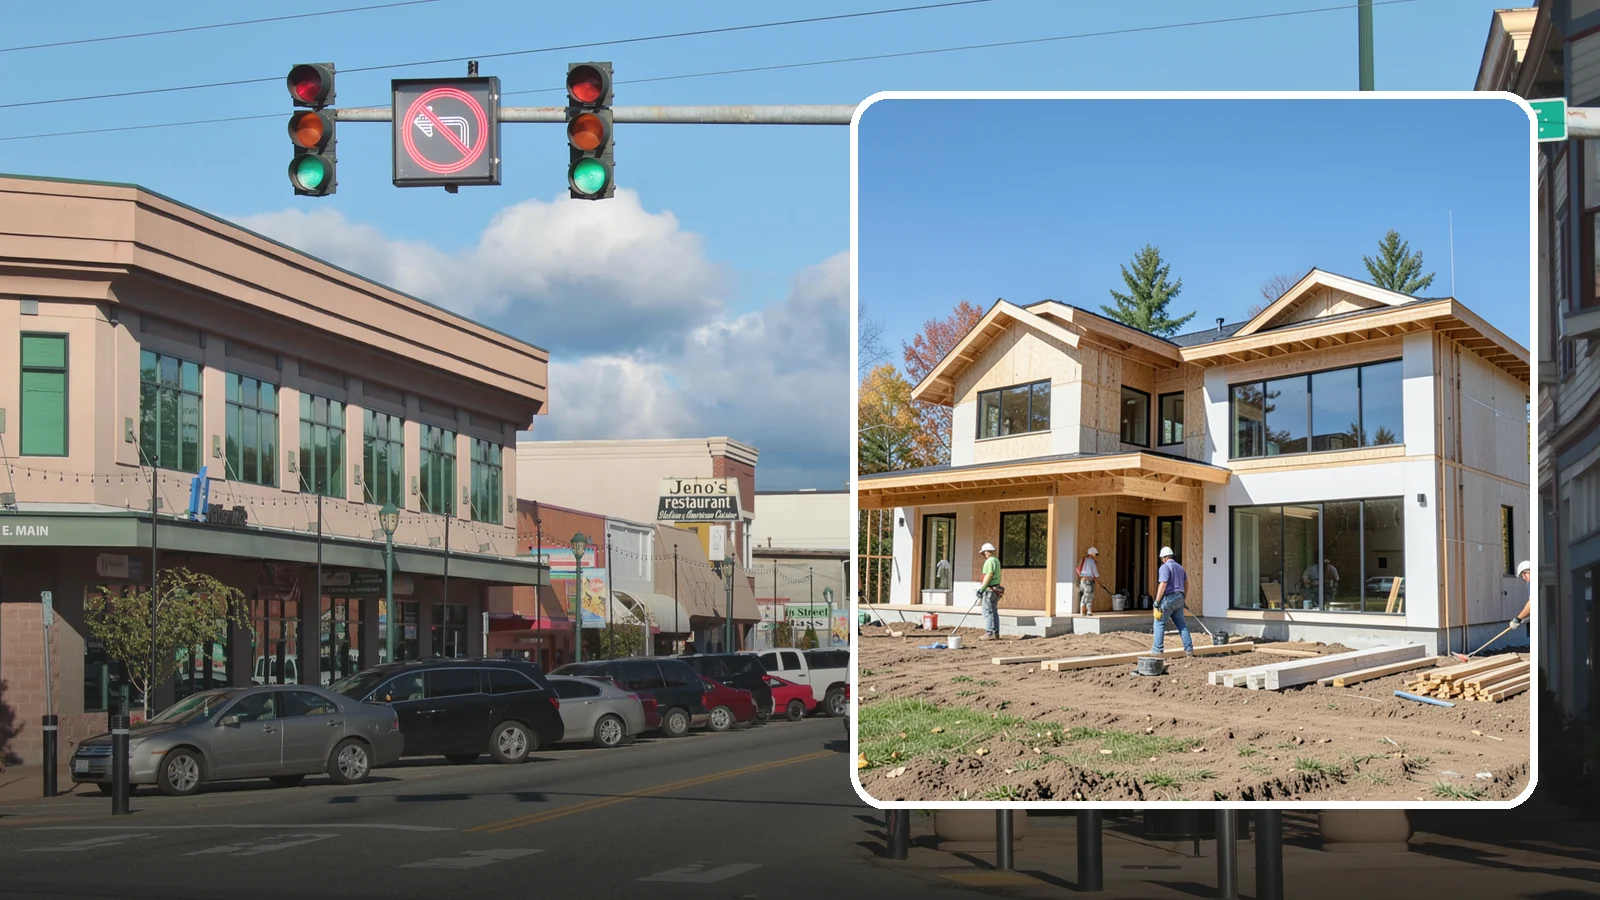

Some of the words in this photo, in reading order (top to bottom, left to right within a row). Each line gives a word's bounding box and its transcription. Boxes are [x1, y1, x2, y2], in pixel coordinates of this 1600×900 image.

[669, 480, 728, 494] Jeno's
[665, 496, 731, 509] restaurant
[658, 510, 681, 519] Italian
[686, 509, 714, 519] American
[715, 509, 738, 519] Cuisine
[2, 525, 13, 536] E.
[15, 525, 49, 536] MAIN
[797, 606, 829, 617] Street
